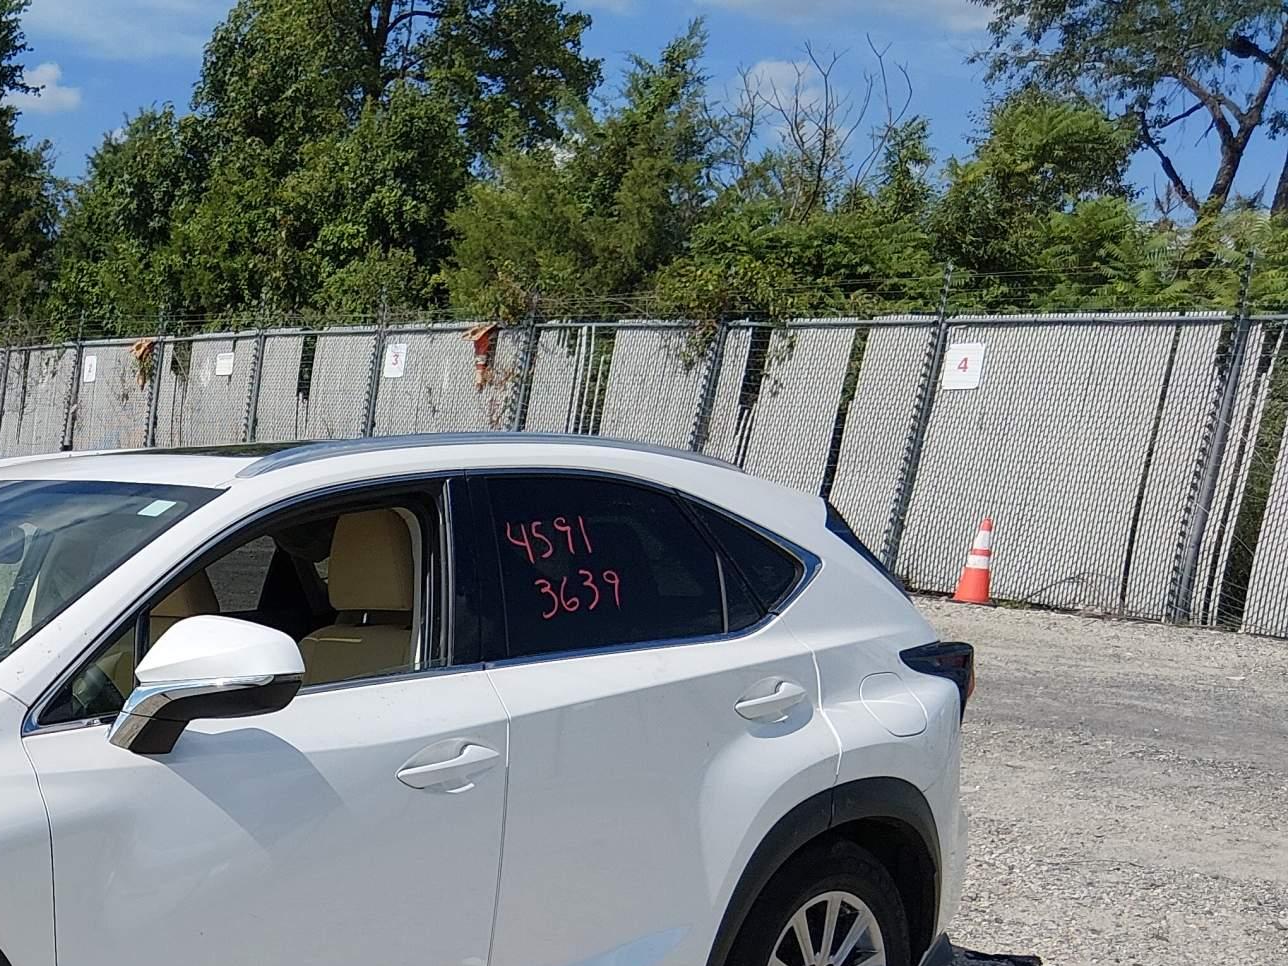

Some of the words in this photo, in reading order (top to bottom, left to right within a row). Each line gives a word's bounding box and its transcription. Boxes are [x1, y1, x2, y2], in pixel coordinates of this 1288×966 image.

[956, 356, 969, 373] 4
[505, 515, 593, 565] 4591
[534, 568, 621, 619] 3639
